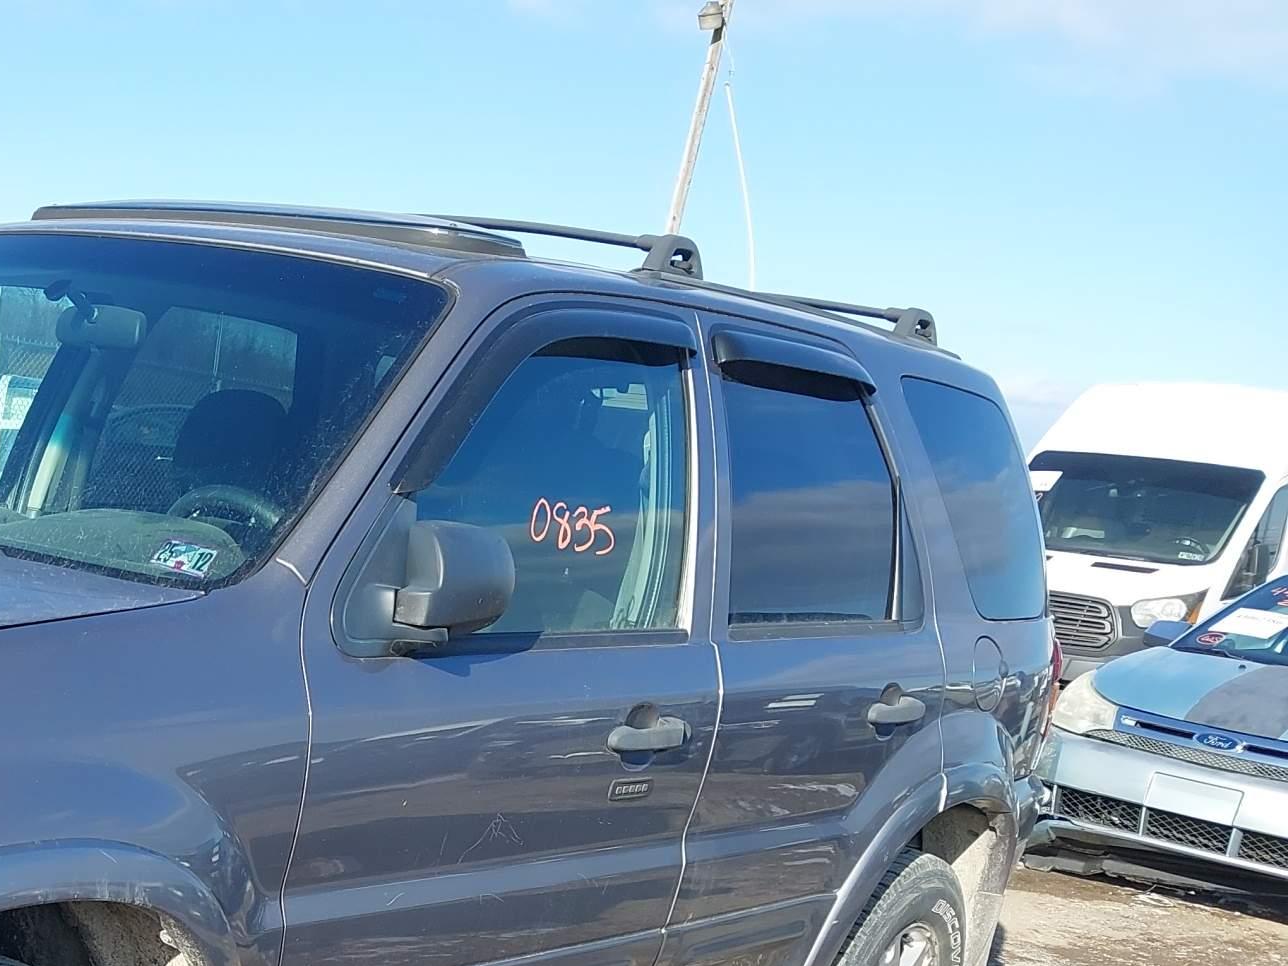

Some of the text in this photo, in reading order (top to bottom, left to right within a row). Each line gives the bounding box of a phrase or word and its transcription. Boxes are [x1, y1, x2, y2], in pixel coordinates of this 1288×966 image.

[530, 498, 615, 555] 0835
[157, 541, 213, 571] 25 12
[1203, 735, 1233, 749] Ford
